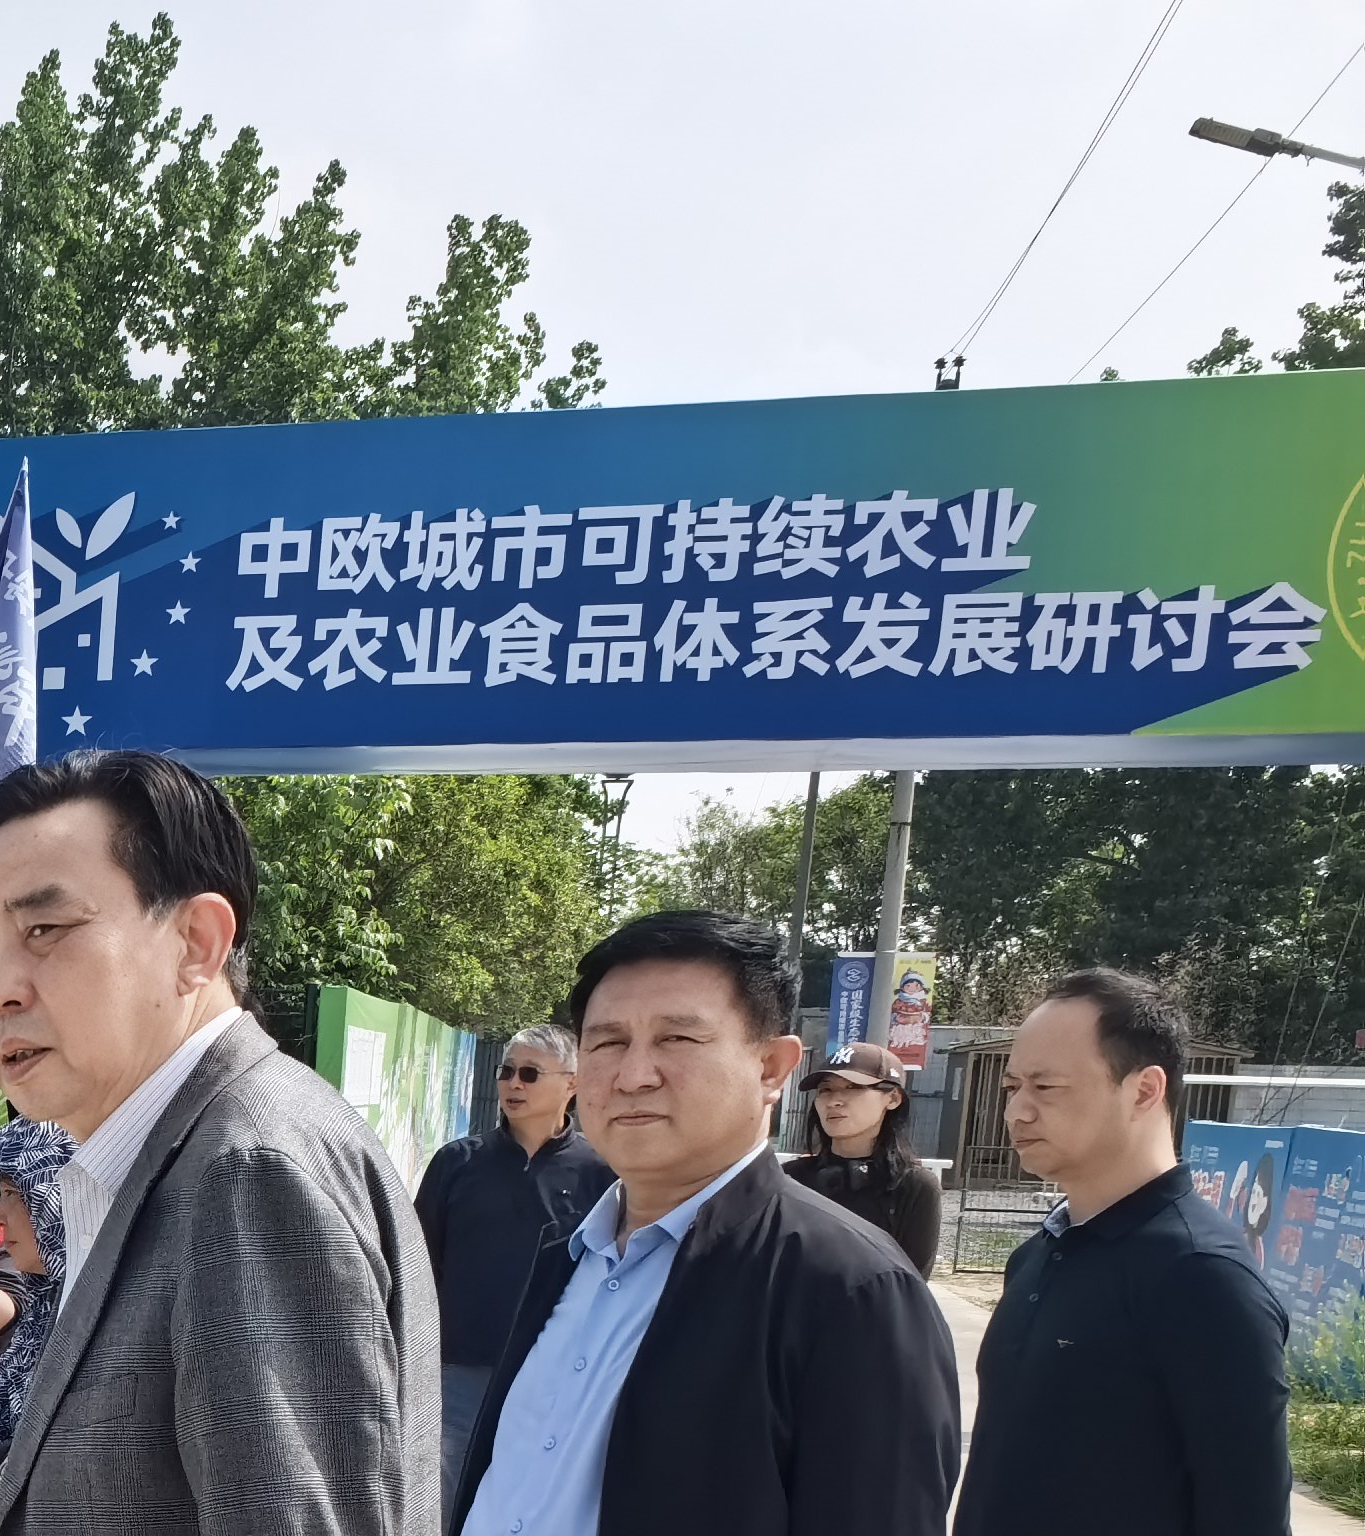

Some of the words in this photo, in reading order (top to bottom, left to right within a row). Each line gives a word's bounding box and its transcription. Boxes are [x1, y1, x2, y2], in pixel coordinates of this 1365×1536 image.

[238, 487, 1038, 598] 中欧城市可持续农业
[225, 582, 1328, 693] 及农业食品体系发展研讨会
